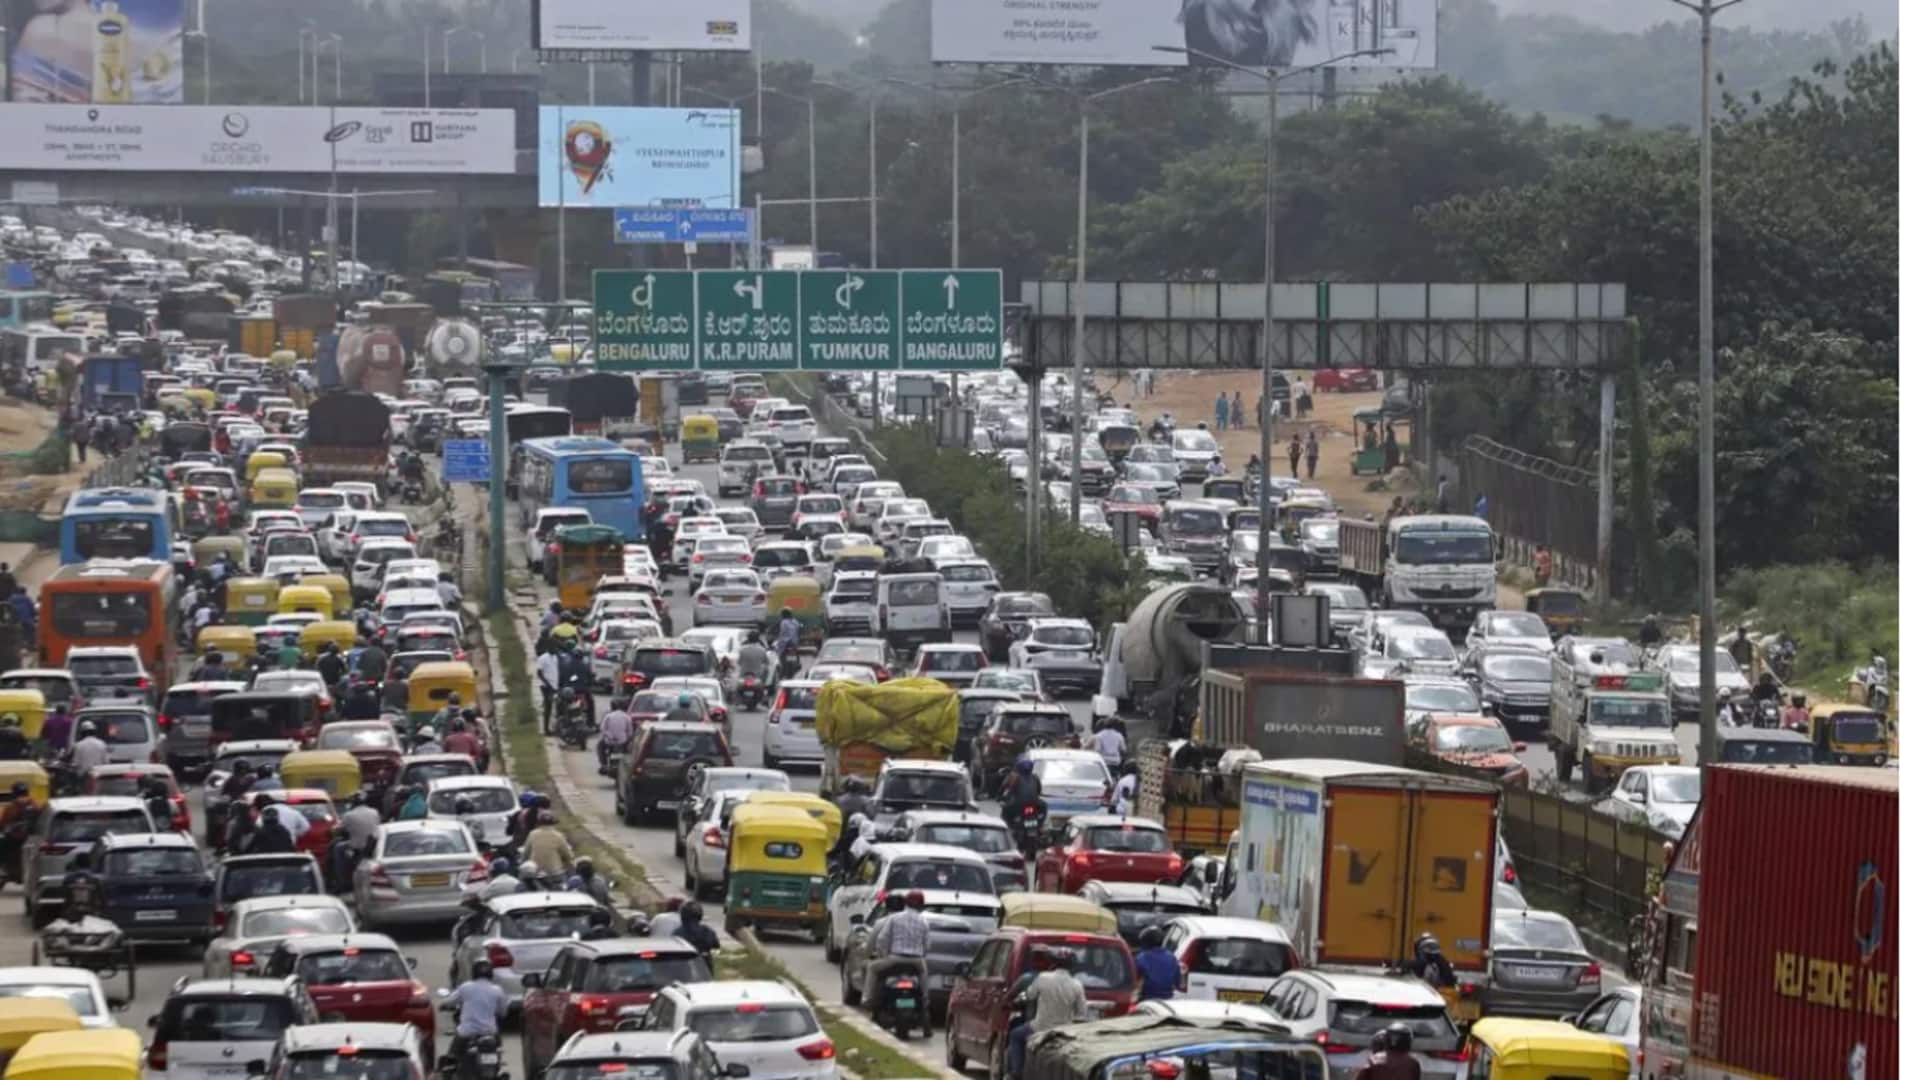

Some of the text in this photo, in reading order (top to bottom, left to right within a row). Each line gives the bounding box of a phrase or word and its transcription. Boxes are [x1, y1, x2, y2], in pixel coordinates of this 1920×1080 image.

[597, 309, 689, 335] ಬೆಂಗಳೂರು
[808, 311, 891, 335] ತುಮಕೂರು
[906, 311, 997, 334] ಬೆಂಗಳೂರು
[598, 343, 690, 361] BENGALURU
[704, 342, 793, 361] K.R.PURAM
[809, 343, 890, 360] TUMKUR
[907, 343, 997, 361] BANGALURU
[1264, 721, 1385, 737] BHARATBENZ
